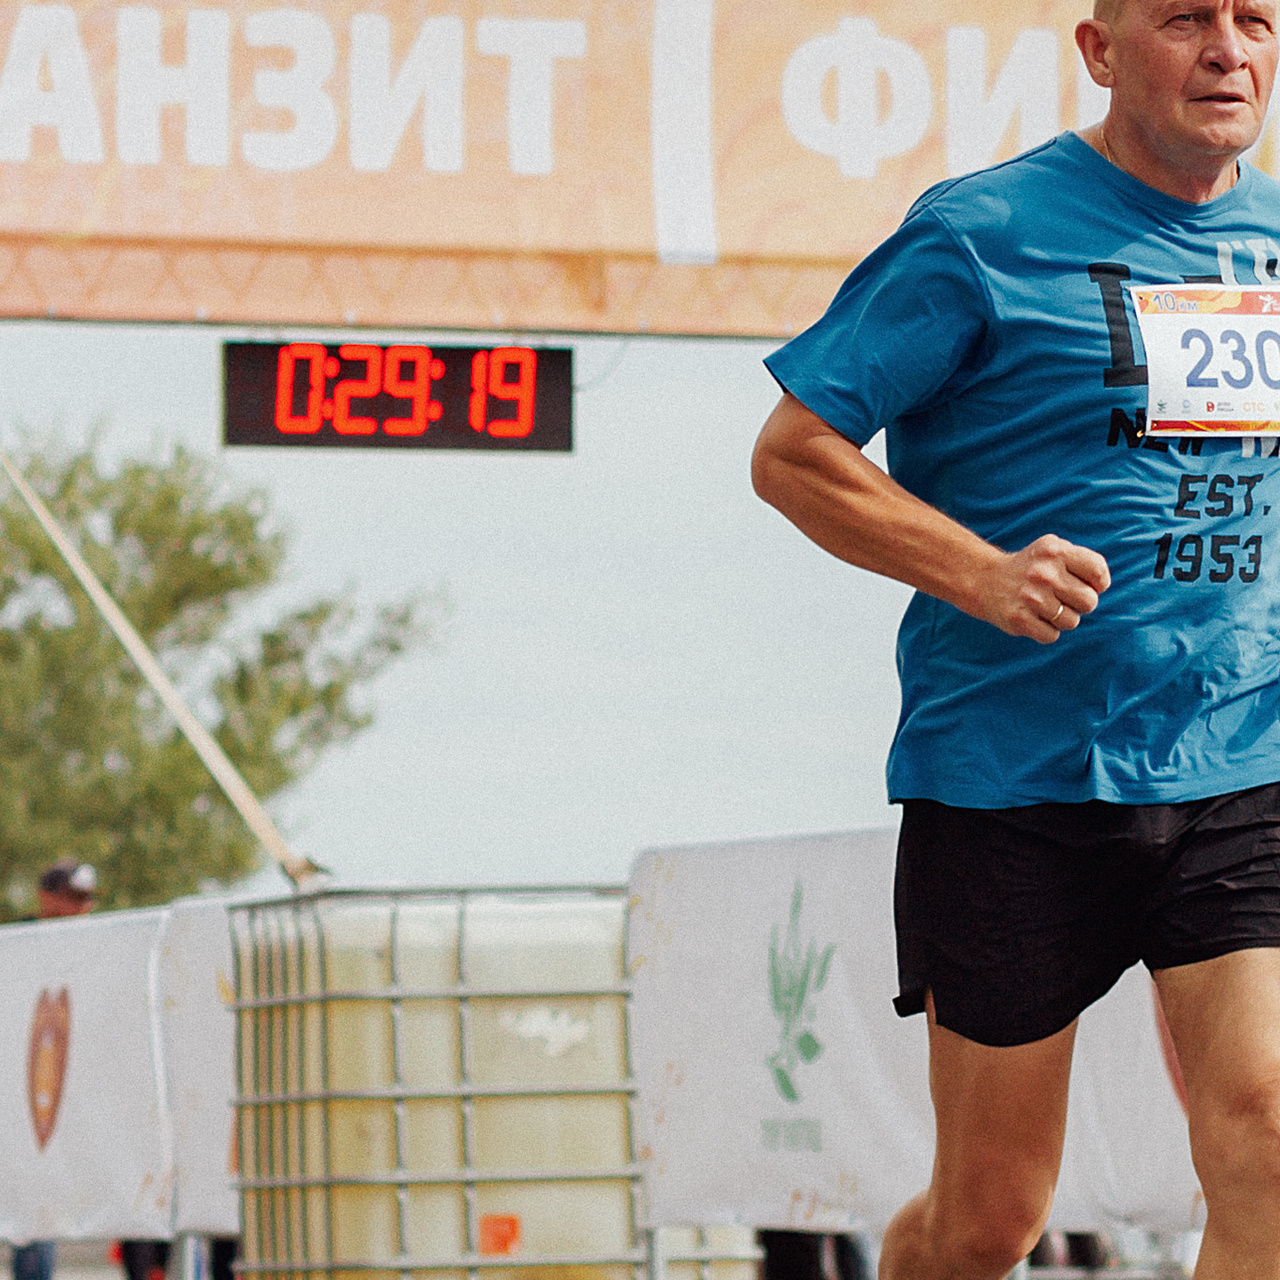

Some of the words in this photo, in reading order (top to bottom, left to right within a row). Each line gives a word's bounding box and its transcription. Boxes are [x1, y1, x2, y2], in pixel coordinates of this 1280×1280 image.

[0, 4, 588, 175] АНЗИТ
[1153, 292, 1176, 311] 10
[275, 343, 538, 437] 0:29:19
[1174, 473, 1271, 519] EST.
[1153, 532, 1263, 583] 1953
